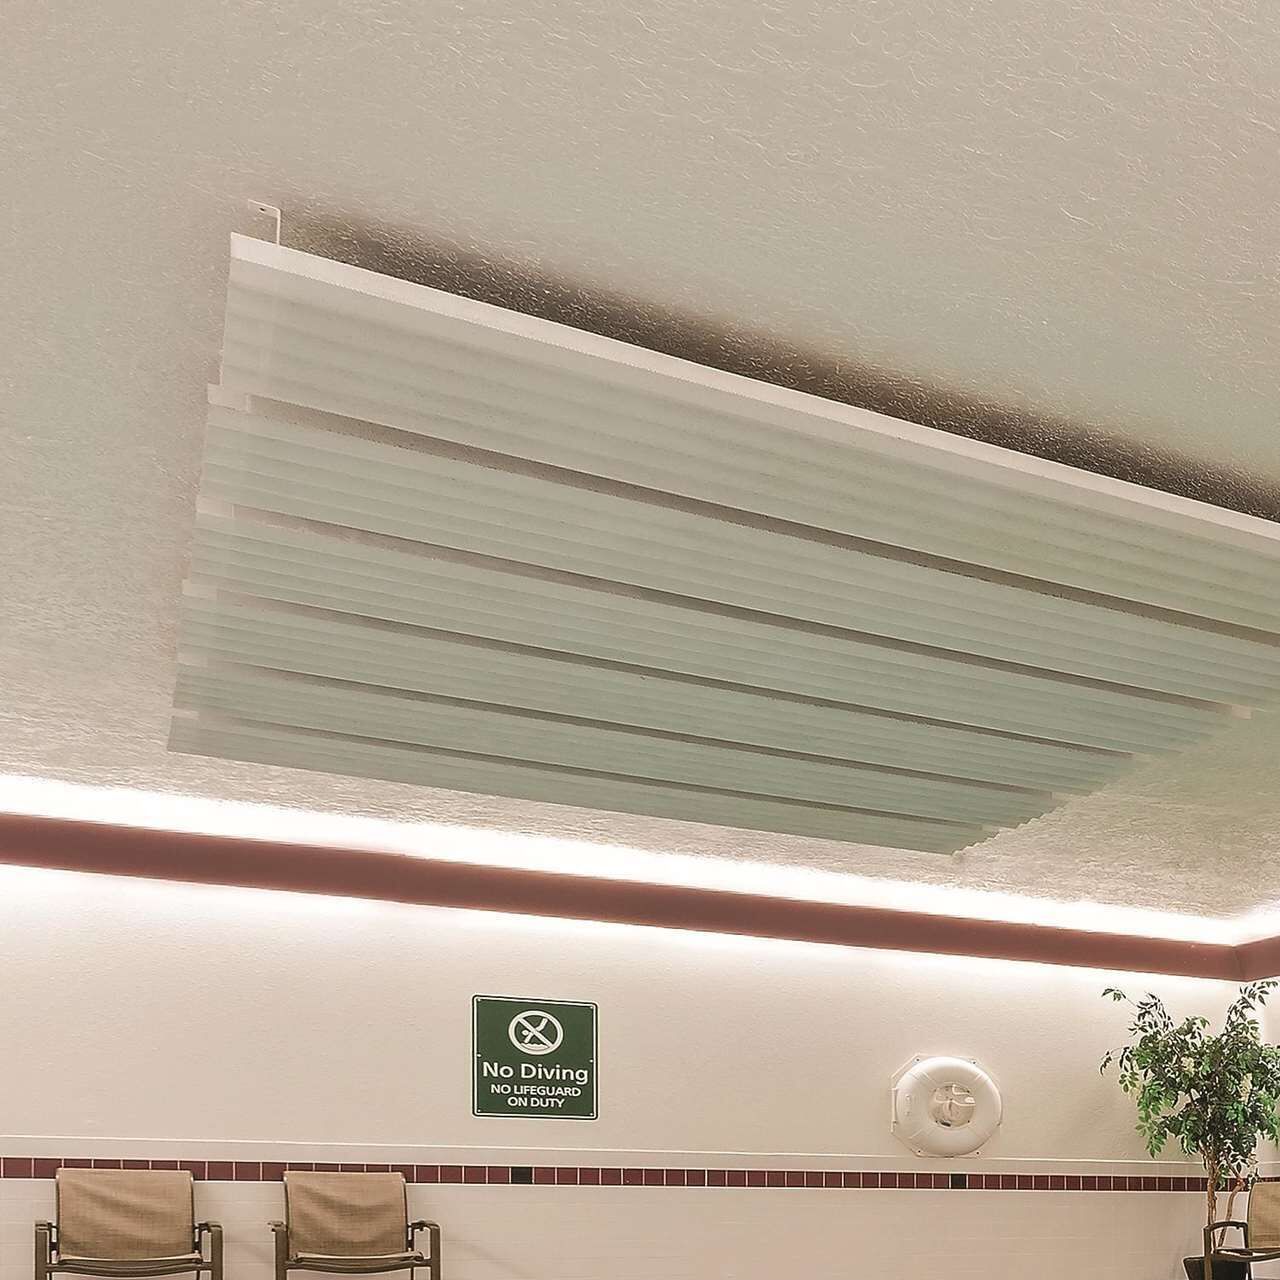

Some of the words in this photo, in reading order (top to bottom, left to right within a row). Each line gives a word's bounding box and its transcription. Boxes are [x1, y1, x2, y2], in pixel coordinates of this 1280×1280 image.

[482, 1061, 514, 1078] No
[520, 1063, 589, 1085] Diving
[490, 1084, 511, 1094] NO
[513, 1085, 582, 1097] LIFEGUARD
[507, 1096, 528, 1107] ON
[530, 1097, 565, 1108] DUTY
